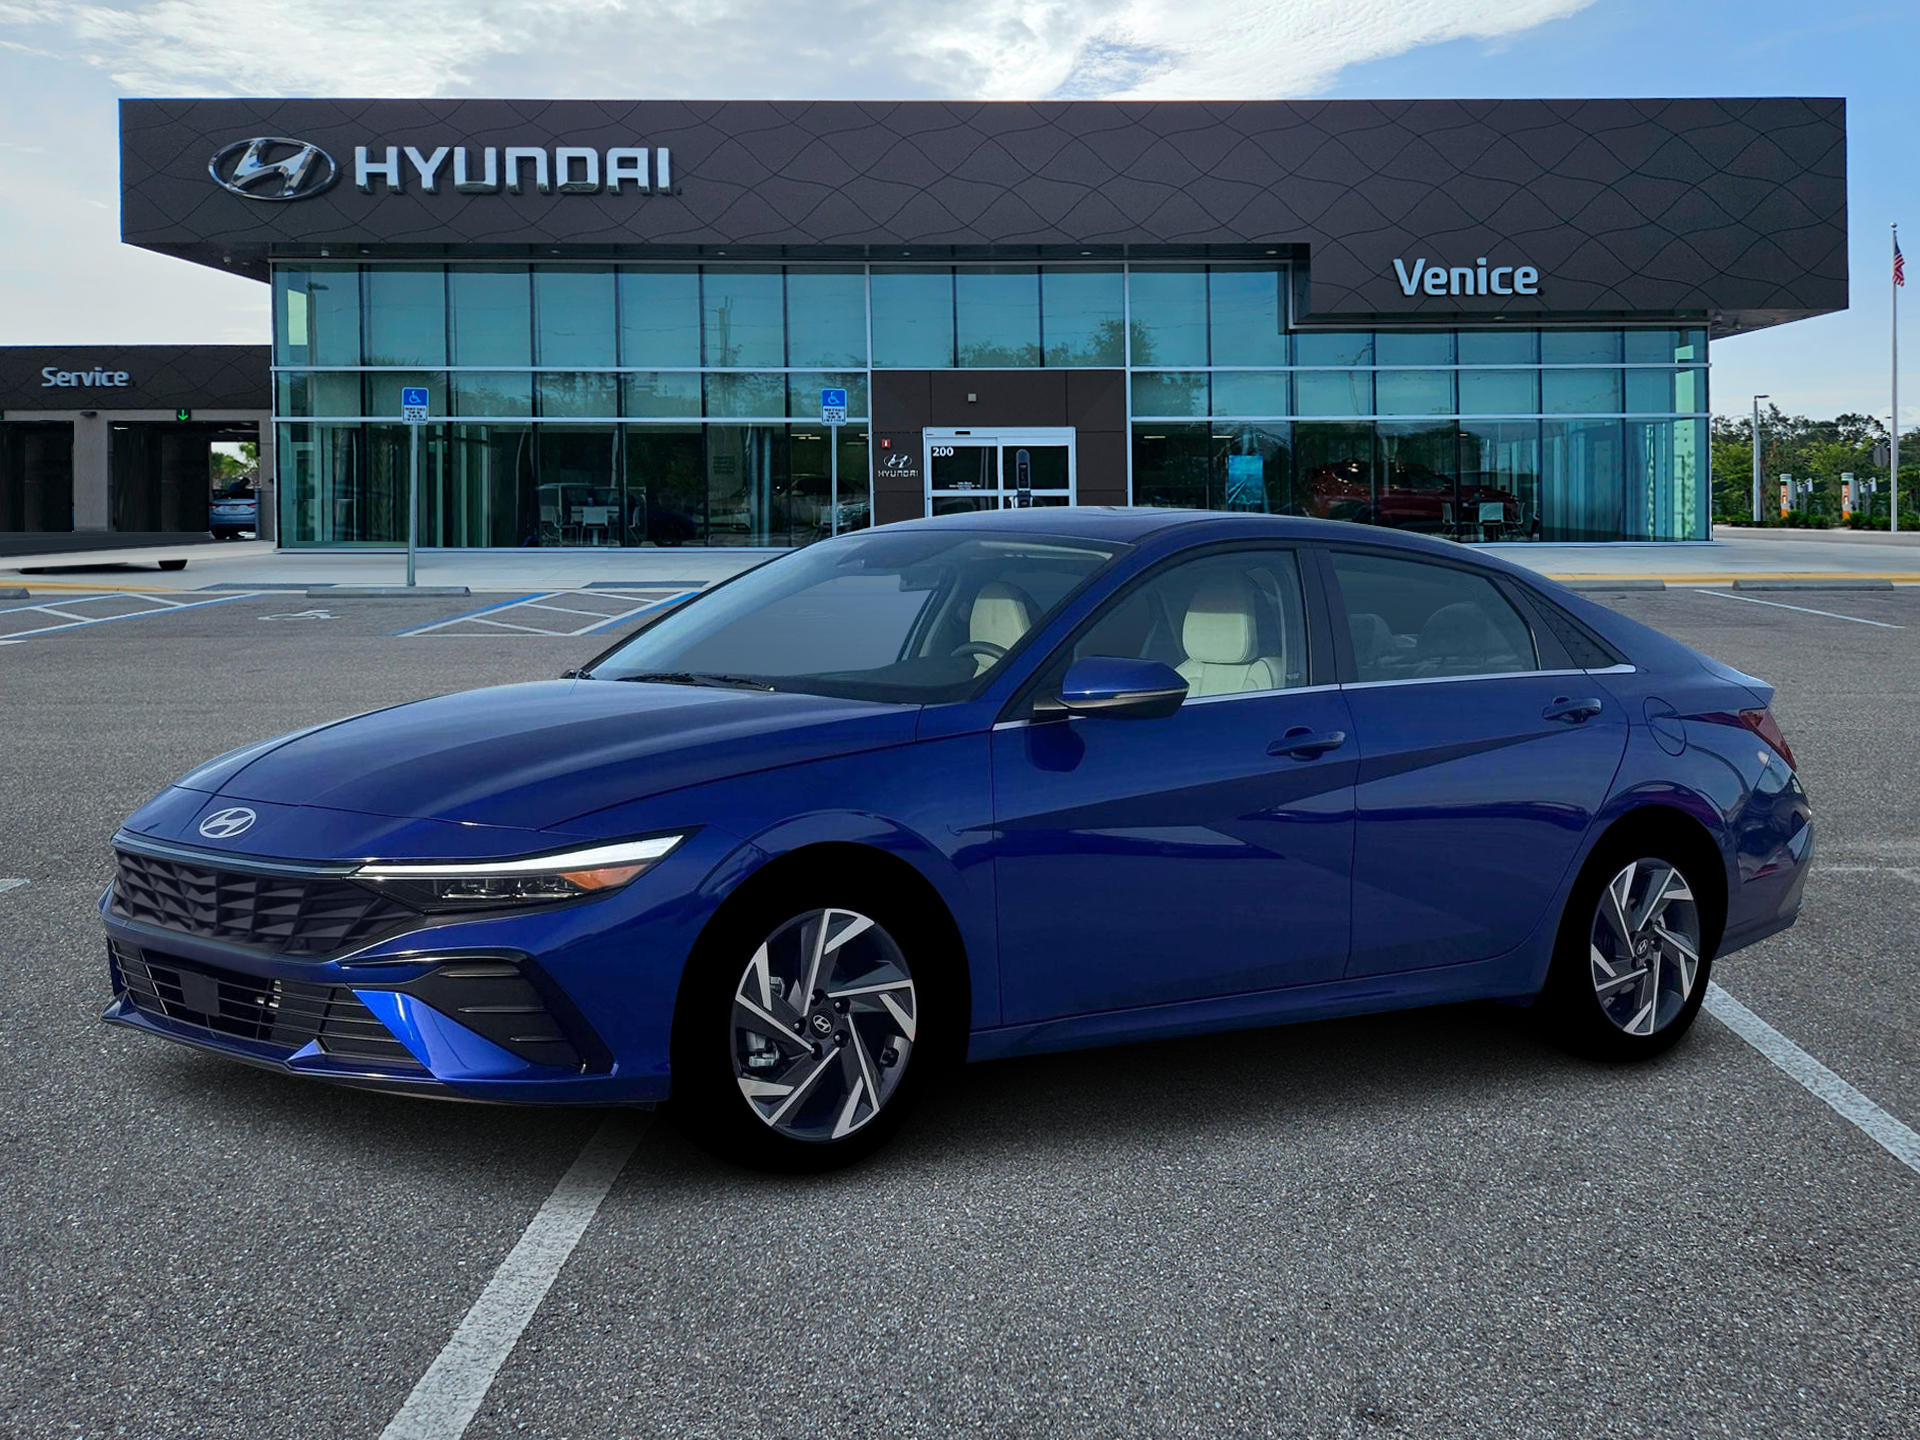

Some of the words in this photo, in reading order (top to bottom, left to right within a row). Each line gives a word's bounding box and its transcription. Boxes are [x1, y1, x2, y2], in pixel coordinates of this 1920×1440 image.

[354, 146, 671, 194] HYUNDAI
[1392, 257, 1539, 296] Venice
[41, 366, 130, 387] Service
[932, 446, 955, 457] 200
[877, 469, 919, 478] HYUNDAI
